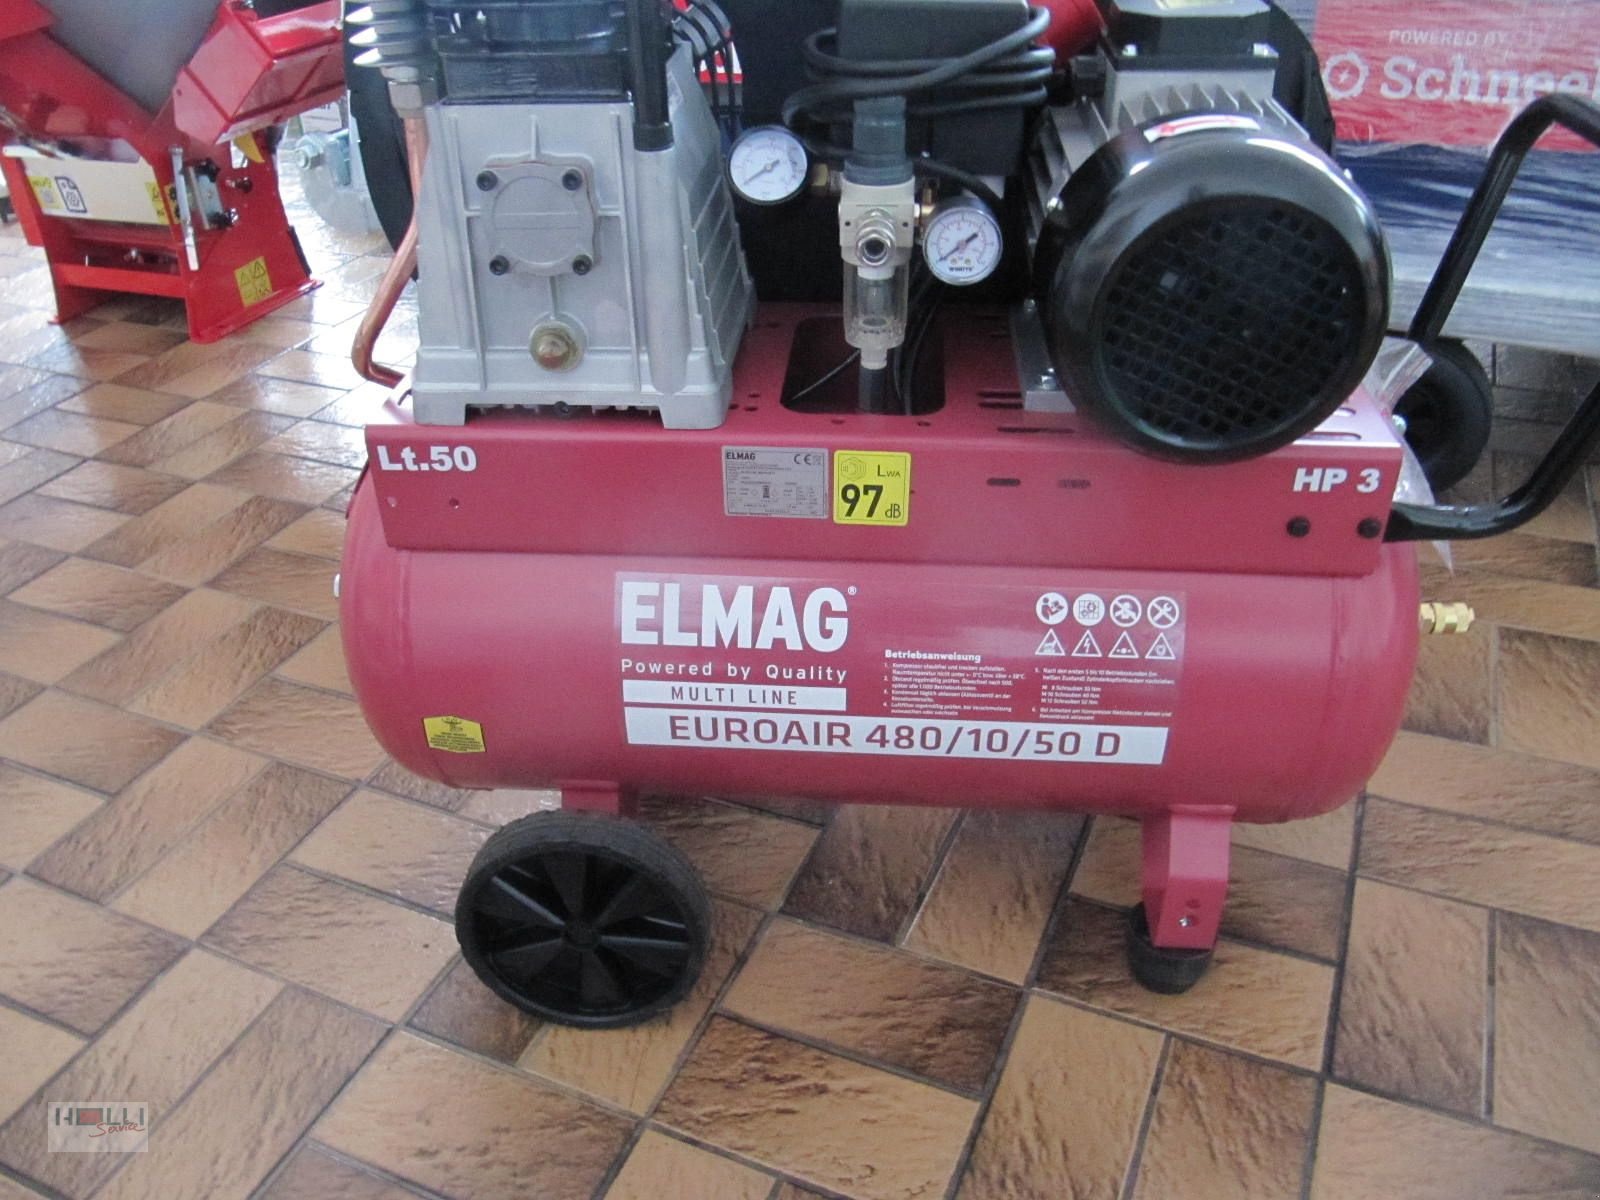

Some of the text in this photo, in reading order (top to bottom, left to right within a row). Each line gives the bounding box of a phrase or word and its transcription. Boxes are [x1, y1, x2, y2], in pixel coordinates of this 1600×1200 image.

[1388, 30, 1477, 46] POWERED
[377, 445, 477, 472] Lt.50
[726, 452, 756, 461] ELMAG
[1293, 467, 1380, 493] HP 3
[841, 483, 884, 518] 97
[884, 503, 902, 519] dB
[621, 581, 849, 653] ELMAG
[885, 649, 982, 664] Betriebsanweisung
[621, 659, 847, 684] Powered by Quality
[671, 686, 797, 705] MULTI LINE
[669, 715, 1121, 757] EUROAIR 480/10/50 D
